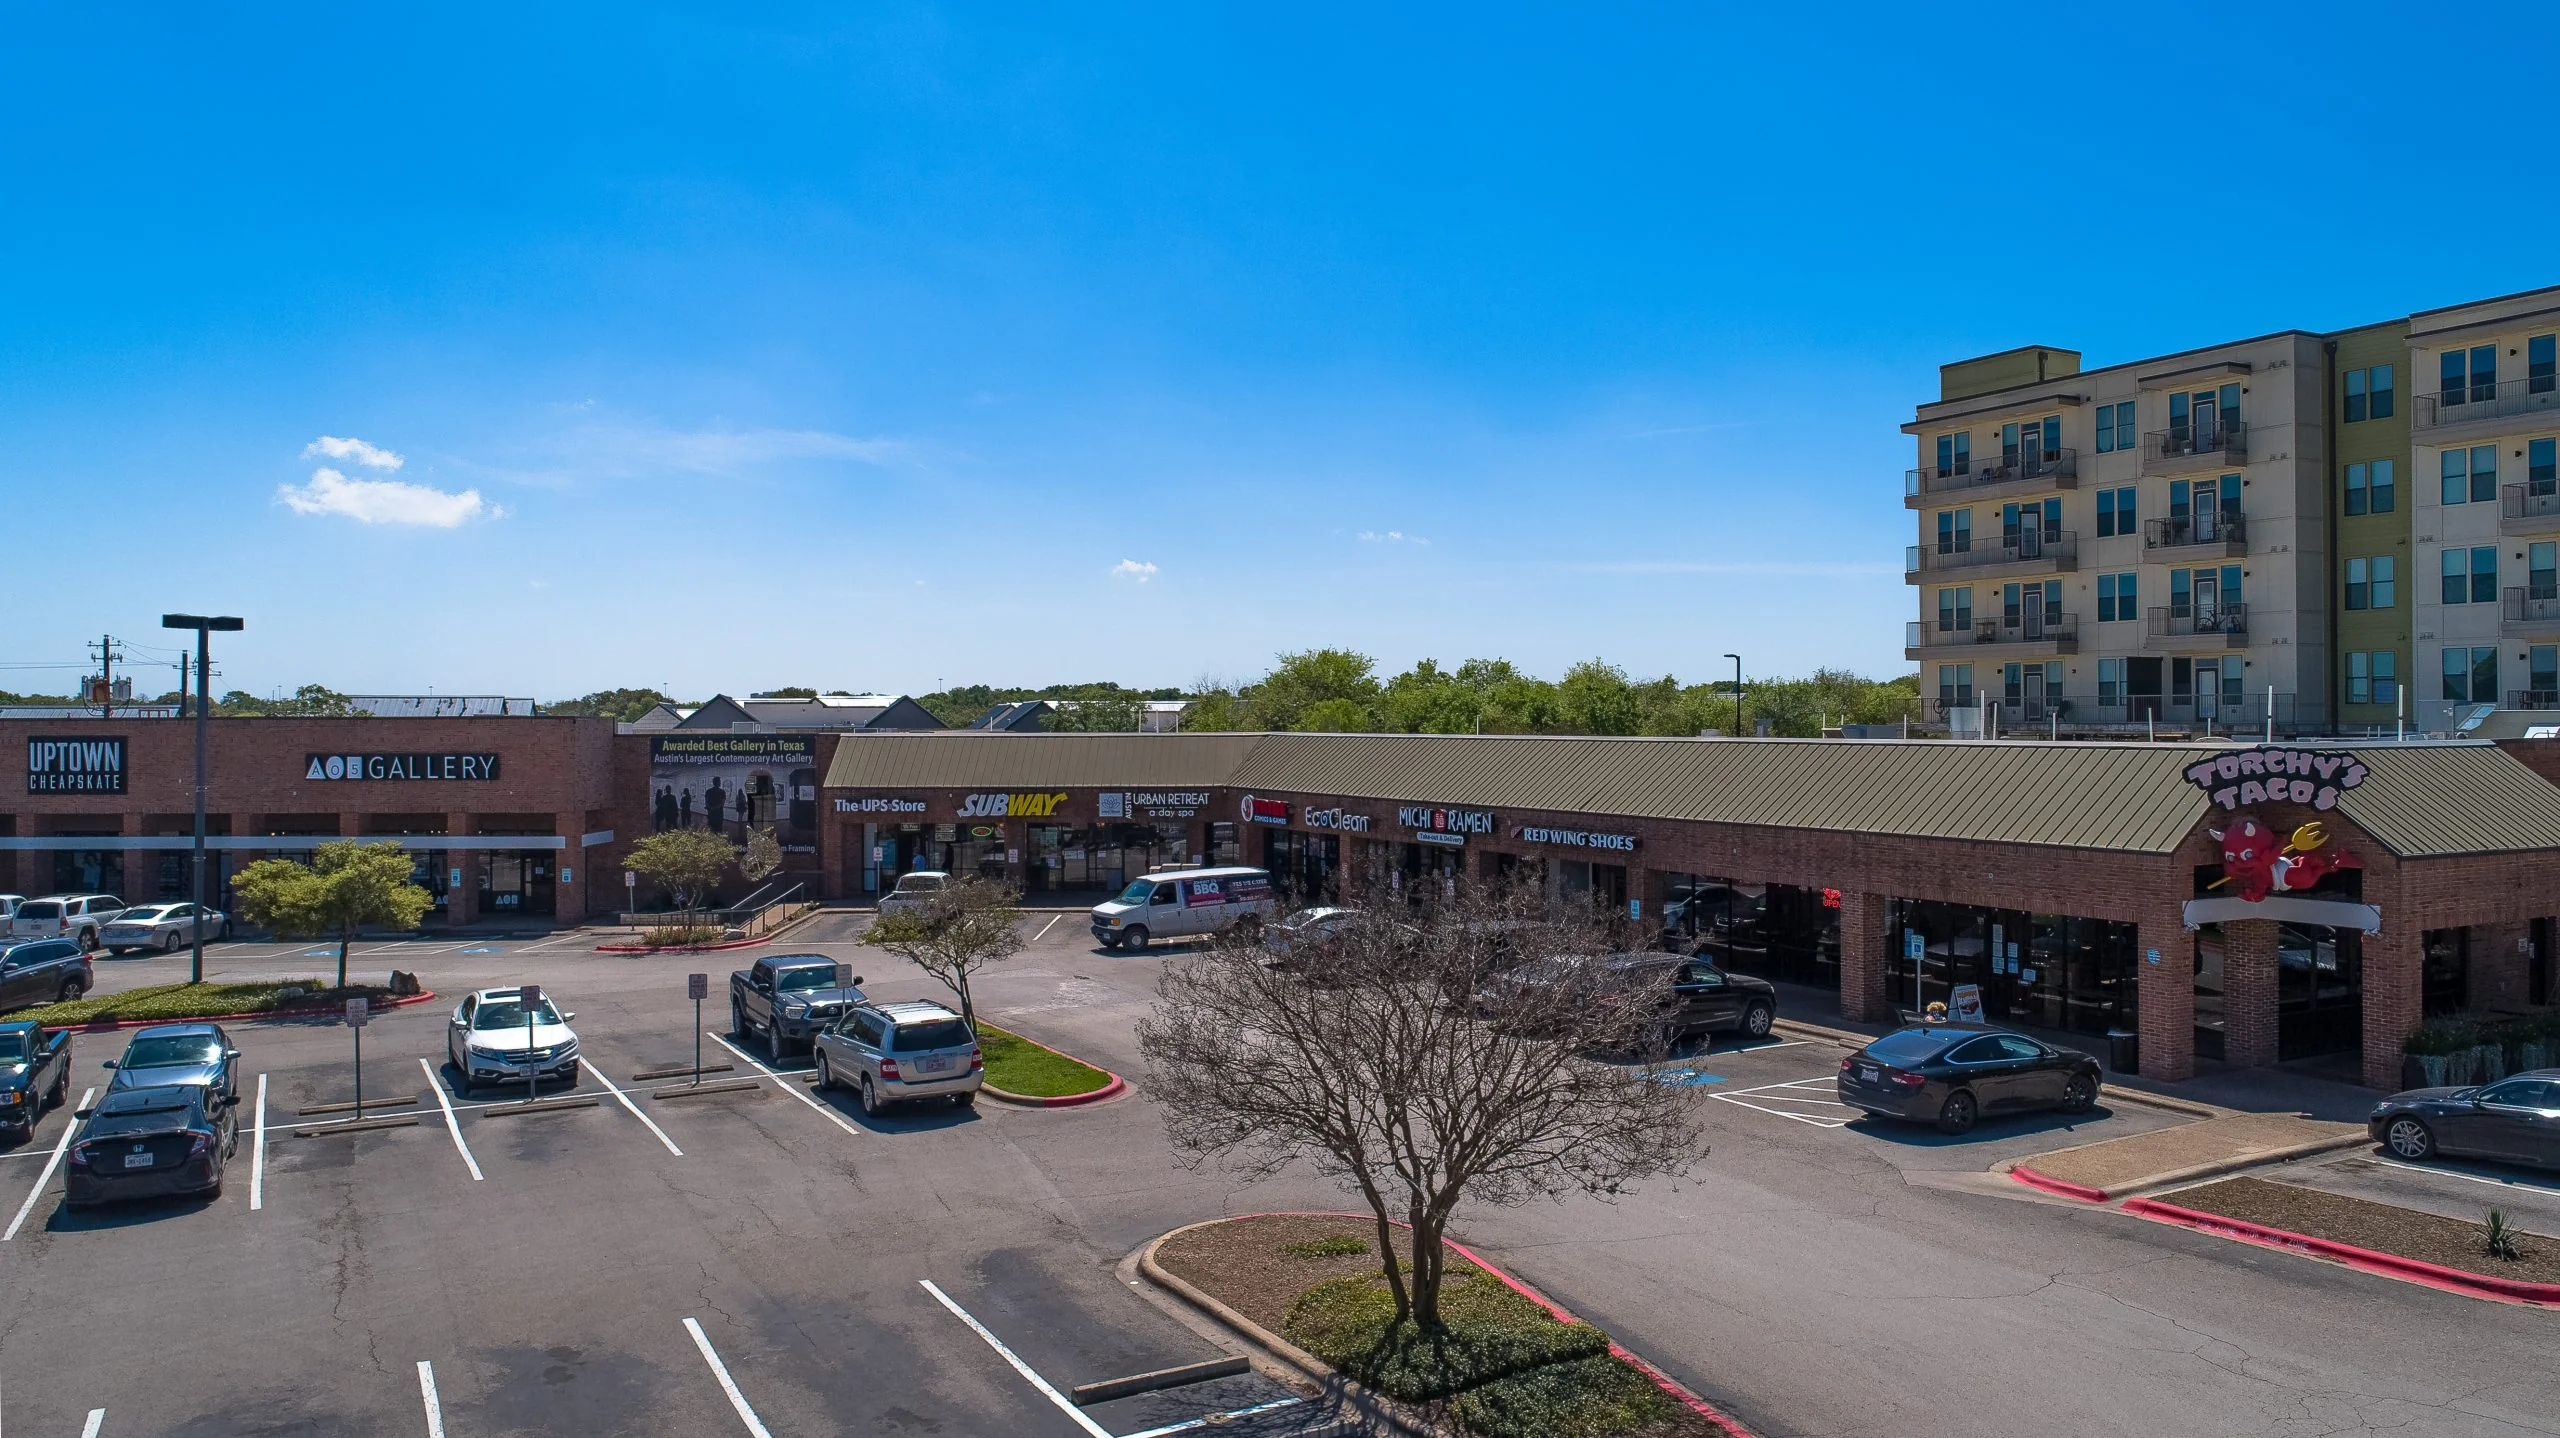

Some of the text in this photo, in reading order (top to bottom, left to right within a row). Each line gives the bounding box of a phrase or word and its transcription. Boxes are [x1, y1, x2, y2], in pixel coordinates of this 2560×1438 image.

[662, 739, 805, 754] Awarded Best Gallery in Texas
[29, 742, 120, 772] UPTOWN
[654, 753, 814, 765] Austin's Largest Contemporary Art Gallery
[368, 756, 495, 780] GALLERY
[2187, 750, 2369, 788] TORCHY'S
[30, 774, 120, 789] CHEAPSKATE
[1133, 793, 1210, 805] URBAN RETREAT
[2213, 777, 2339, 811] TACOS
[834, 799, 926, 812] The UPS Store
[957, 792, 1068, 817] SUBWAY
[1149, 808, 1194, 818] a day spa
[1305, 806, 1369, 832] EcoClean
[1399, 807, 1431, 829] MICHI
[1447, 810, 1492, 833] RAMEN
[788, 844, 816, 854] Framing
[1524, 828, 1549, 842] RED
[1550, 830, 1587, 846] WING
[1589, 833, 1634, 851] SHOES
[1193, 882, 1220, 895] BBQ
